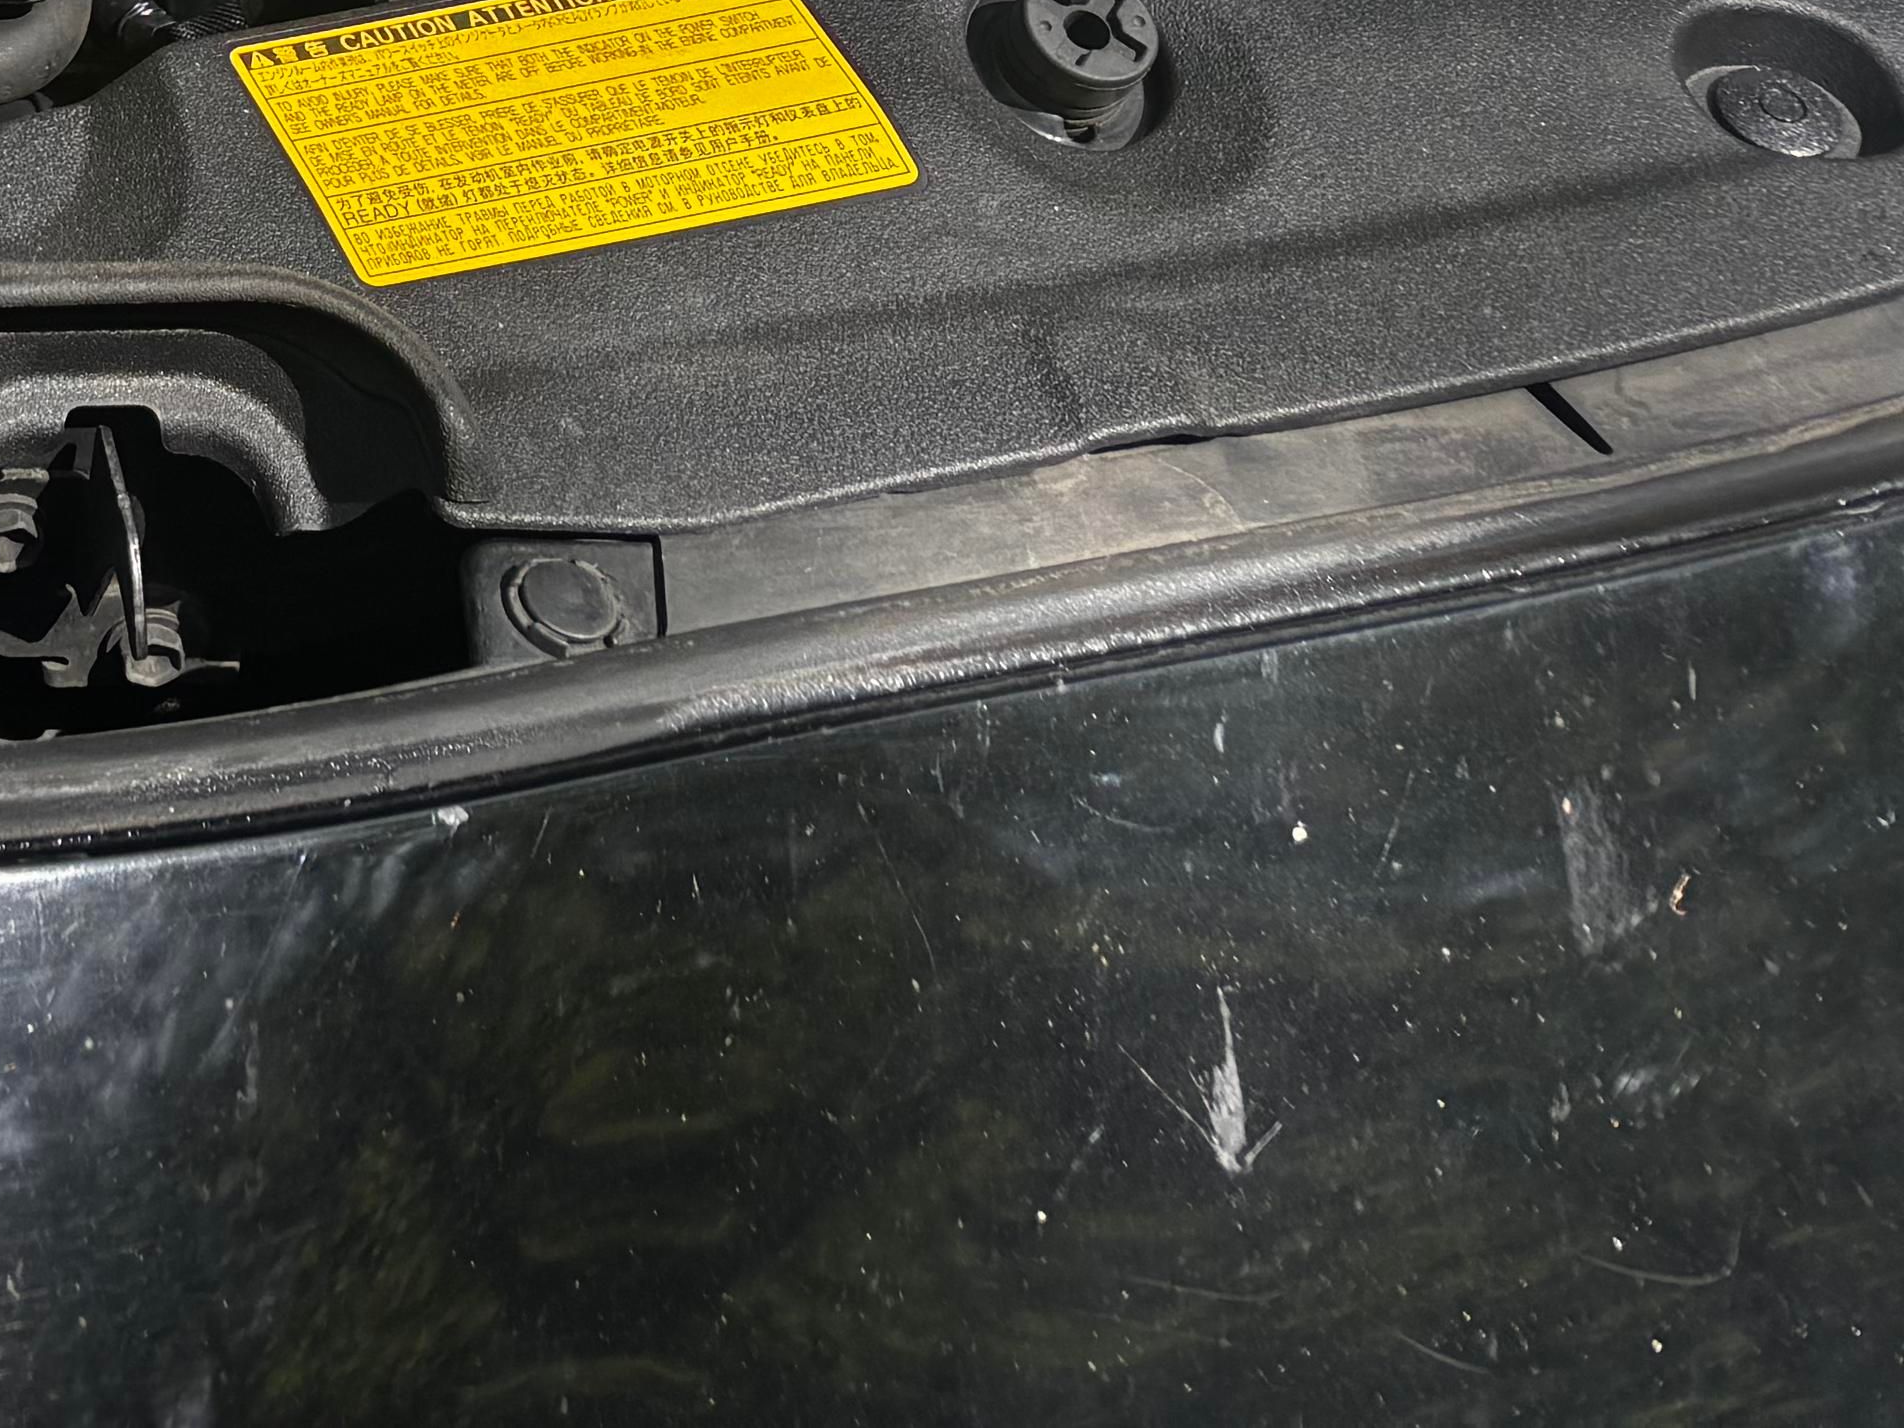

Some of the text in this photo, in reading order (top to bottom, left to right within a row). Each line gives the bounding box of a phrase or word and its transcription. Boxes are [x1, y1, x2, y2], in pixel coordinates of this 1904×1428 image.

[275, 101, 294, 112] TO
[295, 94, 330, 108] AVOID
[375, 77, 416, 93] PLEASE
[418, 70, 450, 84] MAKE
[452, 64, 484, 78] SURE
[484, 58, 515, 72] THAT
[517, 52, 548, 65] BOTH
[550, 46, 575, 59] THE
[576, 35, 632, 54] INDICATOR
[633, 31, 652, 43] ON
[653, 27, 678, 39] THE
[677, 19, 718, 34] POWER
[718, 11, 761, 26] SWITCH
[282, 110, 306, 122] AND
[308, 105, 332, 117] THE
[334, 98, 372, 112] READY
[373, 91, 405, 105] LAMP
[407, 87, 426, 98] ON
[428, 82, 452, 94] THE
[453, 74, 491, 89] METER
[492, 70, 517, 82] ARE
[518, 65, 542, 77] OFF
[543, 56, 586, 72] BEFORE
[586, 46, 638, 63] WORKING
[653, 38, 677, 50] THE
[678, 31, 717, 46] ENGINE
[336, 15, 457, 51] CAUTION
[288, 88, 487, 134] SEE OWNER'S MANUAL FOR DETAILS.
[301, 140, 329, 155] AFIN
[382, 126, 402, 139] DE
[403, 123, 421, 135] SE
[520, 100, 538, 112] DE
[604, 83, 629, 96] QUE
[631, 79, 649, 91] LE
[695, 67, 712, 78] DE
[714, 49, 805, 75] L'INTERRUPTEUR
[308, 154, 326, 167] DE
[328, 148, 358, 163] MISE
[359, 144, 378, 157] EN
[379, 136, 419, 153] ROUTE
[421, 133, 438, 144] ET
[440, 129, 458, 141] LE
[559, 105, 579, 117] DU
[582, 94, 634, 113] TABLEAU
[634, 91, 653, 102] DE
[654, 84, 689, 98] BORD
[689, 77, 722, 91] SONT
[772, 60, 811, 75] AVANT
[812, 56, 831, 67] DE
[392, 120, 567, 162] TOUTE INTERVENTION DANS LE
[322, 130, 584, 189] POUR PLUS DE VOIR LE MANUEL DU
[352, 231, 371, 244] ВО
[374, 215, 451, 240] ИЗБЕЖАНИЕ
[455, 204, 509, 224] ТРАВМЫ
[511, 195, 555, 213] ПЕРЕД
[558, 183, 617, 204] РАБОТОЙ
[634, 166, 702, 189] МОТОРНОМ
[757, 141, 831, 164] УБЕДИТЕСЬ
[359, 242, 387, 257] ЧТО
[470, 222, 490, 235] НА
[800, 158, 821, 171] НА
[823, 147, 877, 166] ПАНЕЛИ
[341, 200, 414, 226] READY
[365, 247, 432, 270] ПРИБОРОВ
[435, 243, 455, 257] НЕ
[506, 219, 583, 243] ПОДРОБНЫЕ
[586, 205, 653, 227] СВЕДЕНИЯ
[786, 173, 818, 188] ДЛЯ
